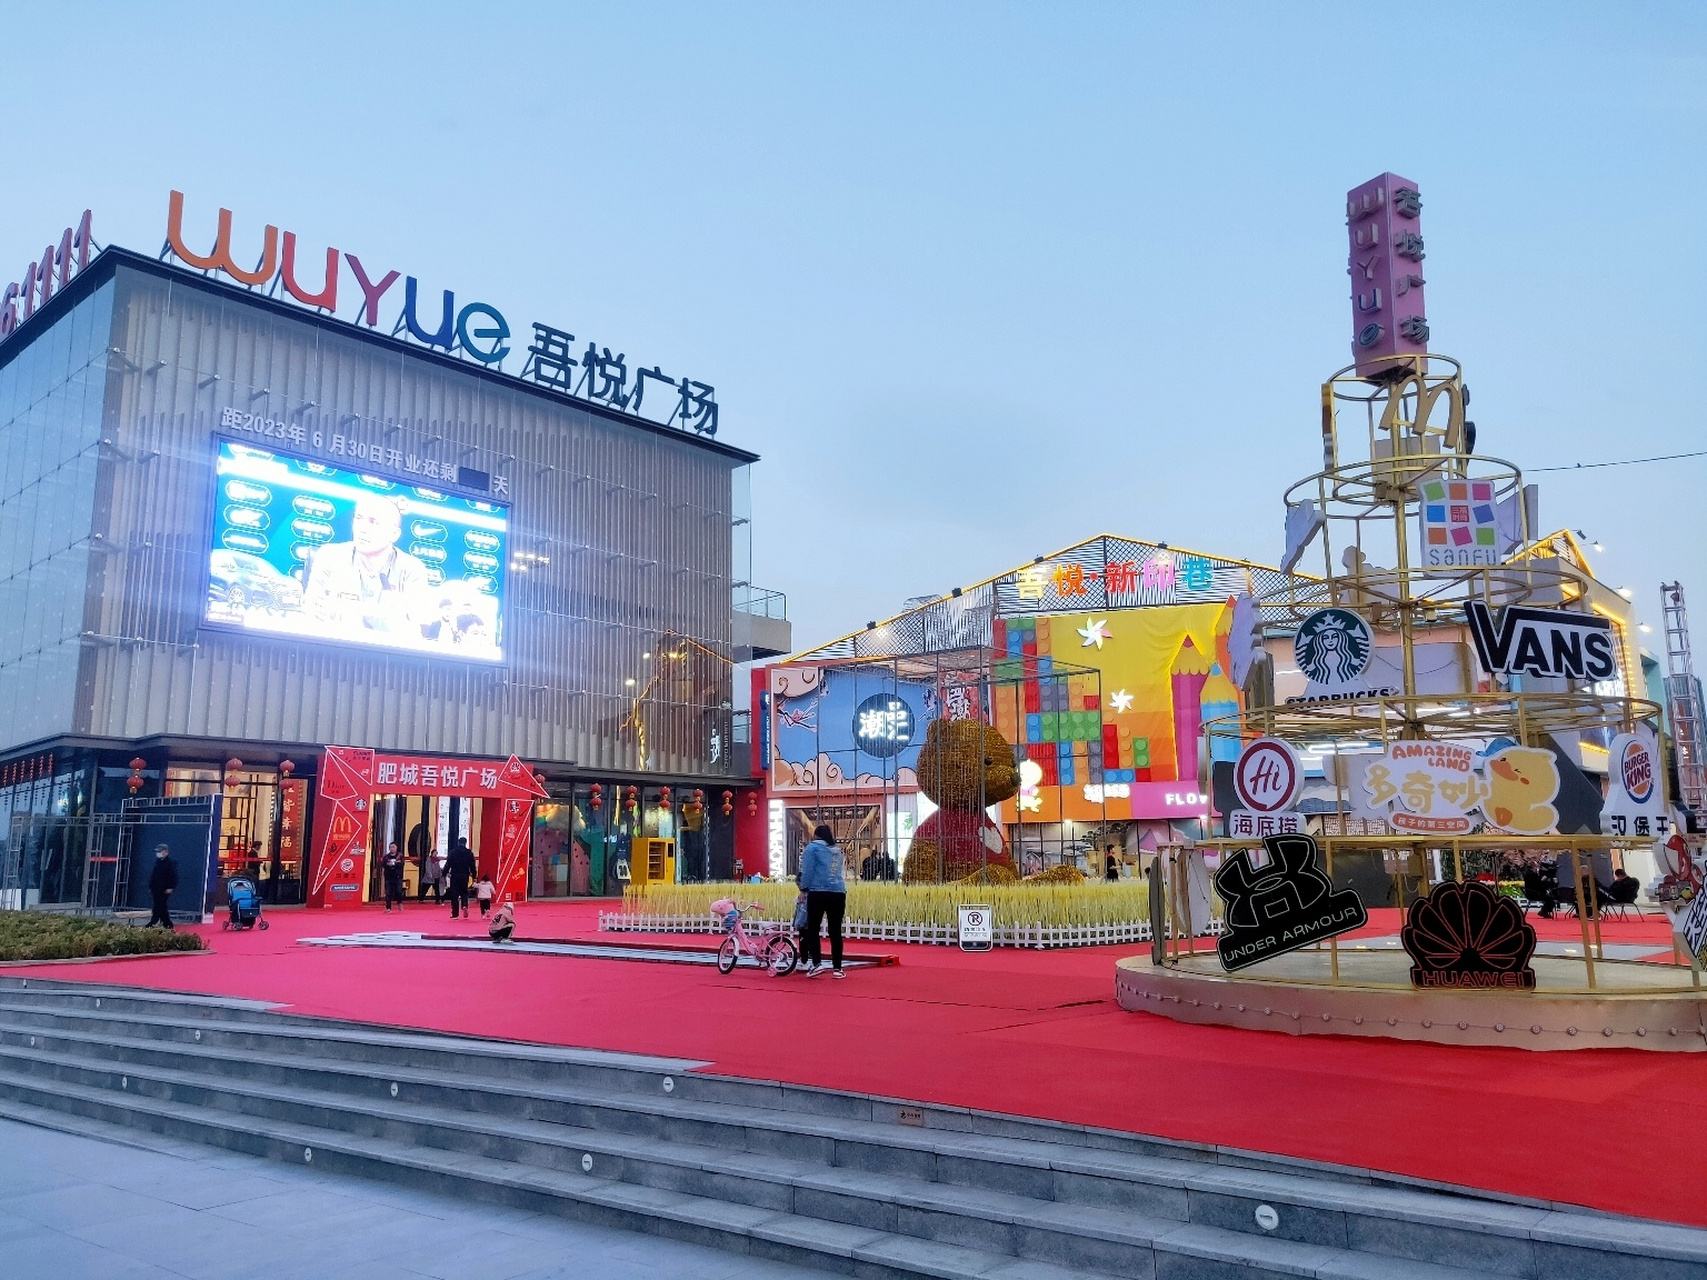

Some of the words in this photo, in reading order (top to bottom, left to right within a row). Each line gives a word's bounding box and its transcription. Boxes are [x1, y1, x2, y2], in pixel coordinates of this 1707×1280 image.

[528, 321, 718, 436] 吾悦广场
[1468, 601, 1618, 680] VANS
[1392, 745, 1472, 761] AMAZING
[1428, 757, 1470, 773] LAND
[1624, 751, 1650, 775] BURGER
[376, 762, 499, 790] 肥城吾悦广场
[1249, 755, 1282, 796] Hi
[1369, 765, 1488, 814] 多奇妙
[1626, 762, 1652, 792] KING
[1224, 936, 1277, 961] UNDER
[1282, 907, 1358, 942] ARMOUR
[1422, 970, 1525, 988] HUAWEI
